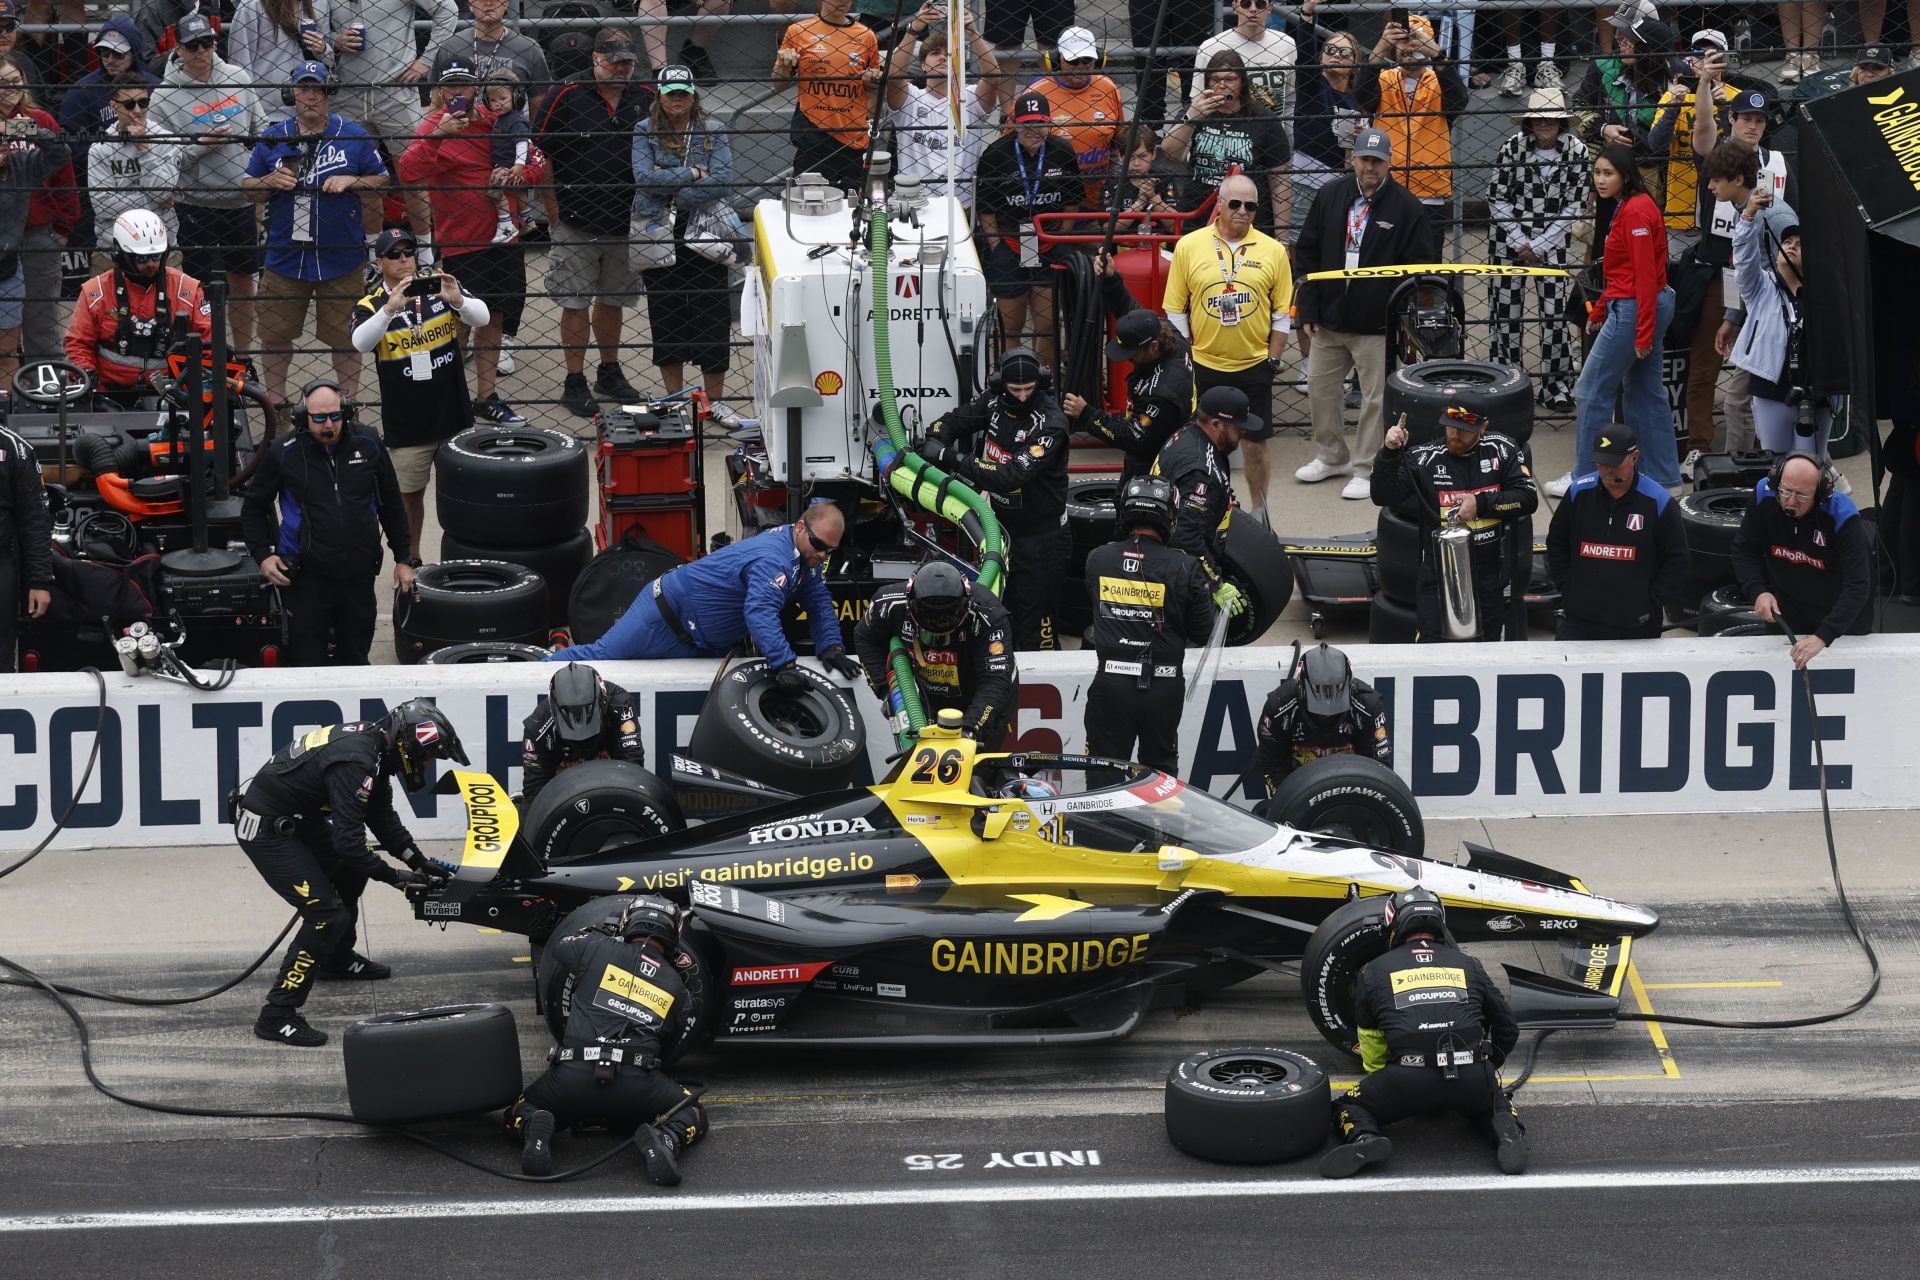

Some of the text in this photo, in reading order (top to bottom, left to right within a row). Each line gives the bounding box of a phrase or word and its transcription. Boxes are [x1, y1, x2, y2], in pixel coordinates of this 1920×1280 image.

[813, 104, 853, 113] McLaren
[1026, 100, 1039, 112] 12
[1006, 191, 1061, 206] verzon
[866, 307, 950, 322] ADRETTI
[1582, 543, 1633, 559] ANDRETTI
[1774, 547, 1824, 568] ANDRETTI
[1110, 583, 1161, 600] GAINBRIDGE
[754, 662, 836, 692] FIAWK
[1112, 662, 1141, 673] ANDRETTI
[835, 694, 855, 731] INDY500
[737, 712, 805, 759] Firestone
[1187, 667, 1856, 800] ABRIDGE
[909, 748, 964, 784] 26
[1066, 798, 1114, 811] GAINBRIDGE
[1308, 786, 1413, 837] FIREHAWK INDY500
[469, 783, 501, 853] GROUP1001
[749, 812, 824, 831] POWERED by
[907, 815, 926, 824] Herta
[748, 816, 876, 845] HONDA
[643, 867, 694, 890] visit
[700, 852, 875, 883] gainbridge.io
[692, 879, 705, 903] GROUP
[704, 884, 722, 908] 1001
[425, 907, 460, 915] HYBRID
[769, 900, 780, 922] CURB
[1160, 889, 1196, 915] Firestone
[931, 932, 1151, 975] GAINBRIDGE
[734, 968, 800, 982] ANDRETTI
[832, 966, 860, 976] CURB
[1406, 972, 1462, 984] GAINBRIDGE
[617, 977, 669, 1010] GAINBRIDGE
[843, 983, 873, 992] UniFirst
[1318, 951, 1337, 1030] FIREHAWK
[1408, 990, 1457, 1002] GROUP1001
[607, 998, 653, 1023] GROUP1001
[733, 996, 786, 1010] stratasys
[761, 1013, 776, 1021] NTT
[728, 1024, 777, 1034] Firestone
[1188, 1081, 1266, 1096] FIREHAWK
[903, 1150, 1101, 1171] INDY 25
